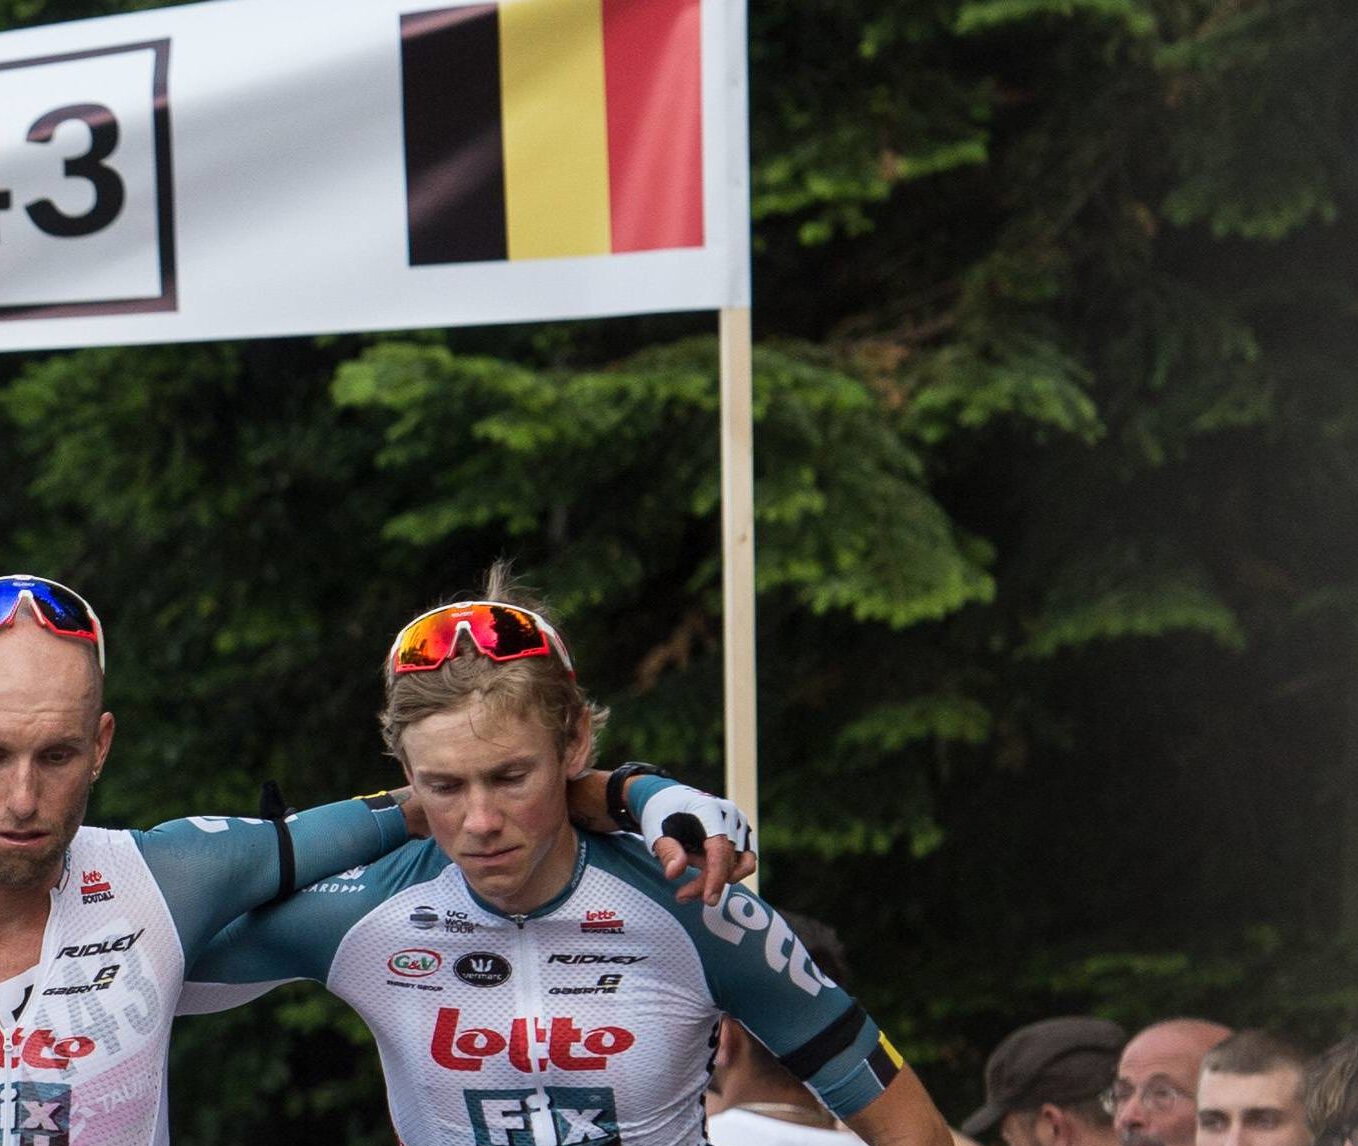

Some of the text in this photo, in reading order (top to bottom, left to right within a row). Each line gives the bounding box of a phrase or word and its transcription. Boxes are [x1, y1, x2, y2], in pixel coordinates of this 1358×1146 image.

[302, 883, 339, 893] ARD
[446, 910, 468, 919] UCI
[56, 928, 145, 960] RIDLEY
[547, 954, 648, 966] RIDLEY
